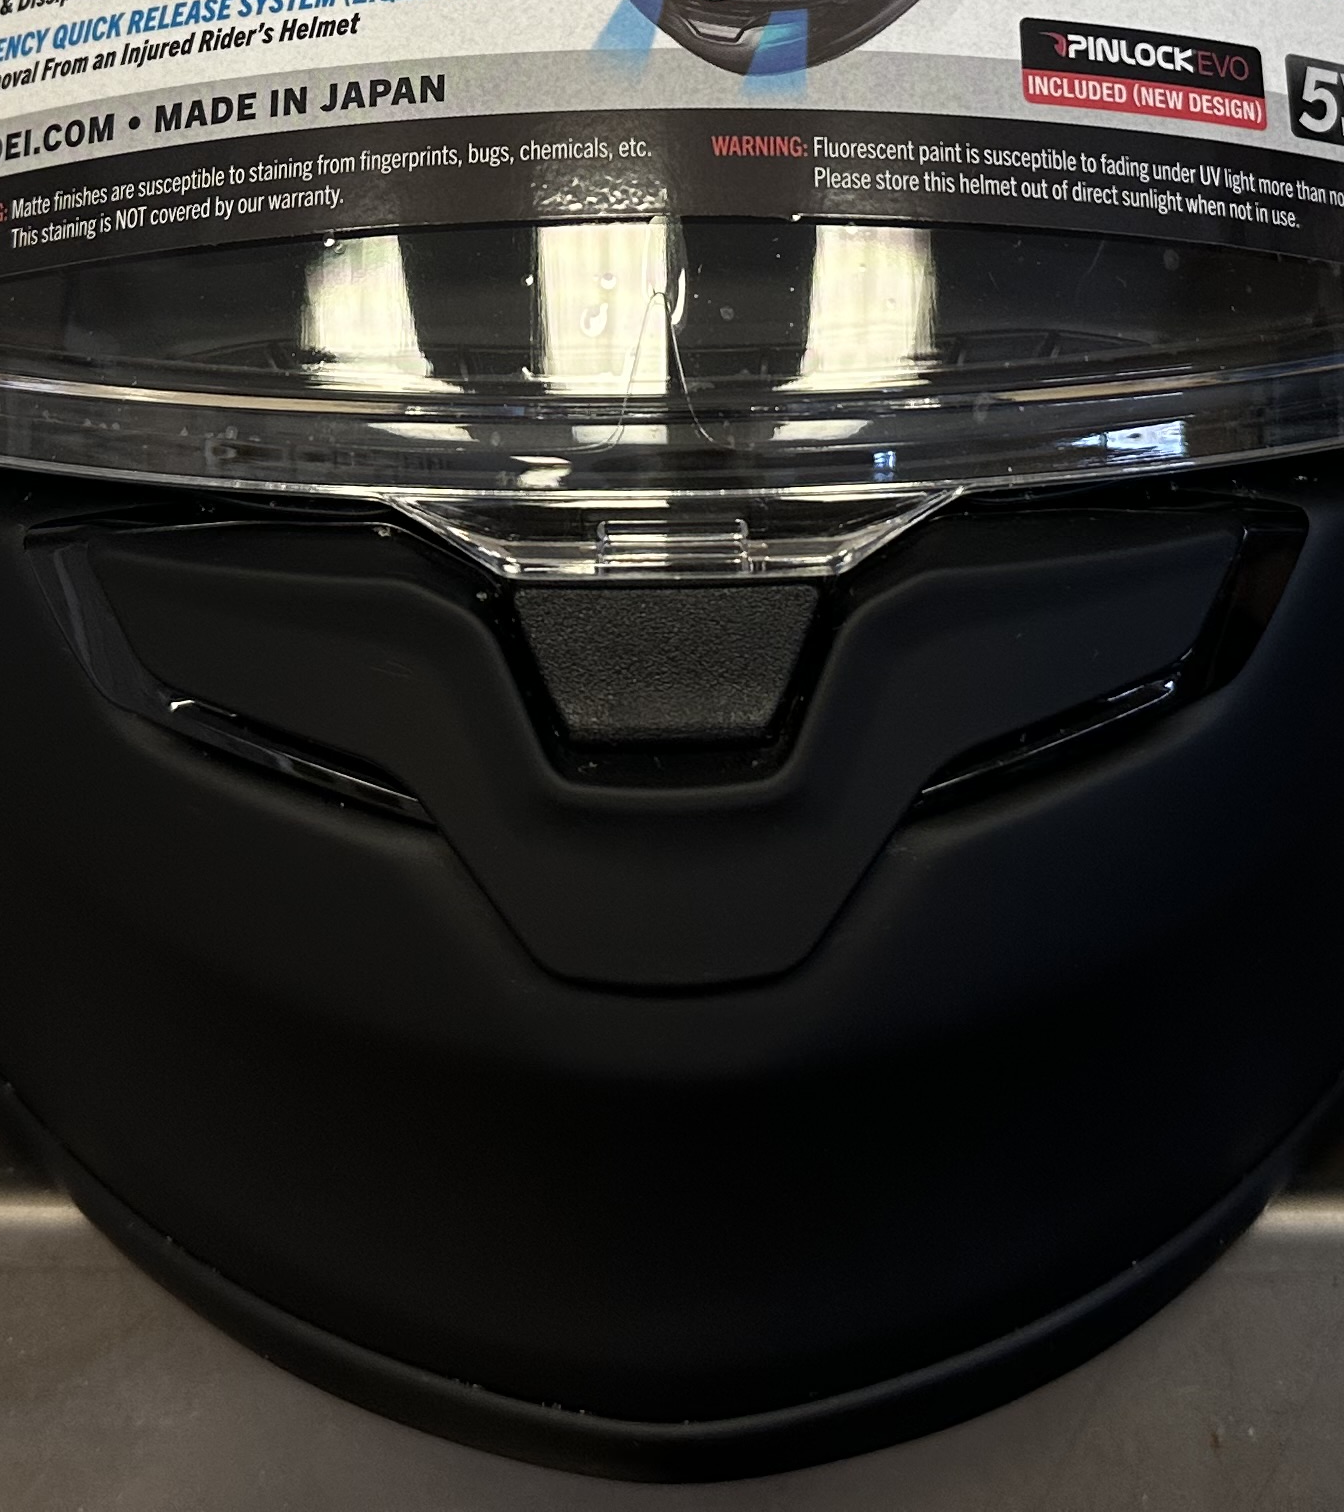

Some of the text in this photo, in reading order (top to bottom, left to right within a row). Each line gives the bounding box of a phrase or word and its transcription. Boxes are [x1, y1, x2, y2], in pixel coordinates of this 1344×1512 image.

[41, 56, 88, 81] From
[92, 50, 116, 69] an
[120, 34, 199, 68] Injured
[198, 22, 274, 53] Rider’s
[279, 13, 360, 43] Helmet
[53, 12, 125, 49] QUICK
[156, 92, 256, 133] MADE
[270, 86, 308, 118] IN
[320, 73, 445, 113] JAPAN
[1028, 75, 1262, 124] INCLUDED (NEW DESIGN)
[1299, 66, 1340, 133] 5
[12, 192, 50, 220] Matte
[54, 186, 108, 213] finishes
[111, 181, 135, 201] are
[138, 164, 225, 197] susceptible
[229, 165, 245, 186] to
[249, 158, 312, 185] staining
[317, 154, 355, 176] from
[360, 144, 463, 174] fingerprints,
[468, 142, 514, 166] bugs,
[519, 138, 613, 161] chemicals,
[619, 138, 652, 158] etc.
[711, 135, 808, 158] WARNING:
[813, 137, 915, 162] Fluorescent
[919, 143, 962, 164] paint
[966, 144, 980, 165] is
[984, 145, 1076, 172] susceptible
[1080, 152, 1097, 173] to
[1101, 153, 1150, 183] fading
[1153, 161, 1195, 184] under
[1200, 166, 1221, 187] UV
[1225, 169, 1255, 194] light
[1258, 176, 1294, 198] more
[1296, 181, 1326, 205] than
[814, 167, 1300, 228] Please store this helmet out of direct sunlight when not in use.
[11, 186, 344, 249] This staining is NOT covered by our warranty.
